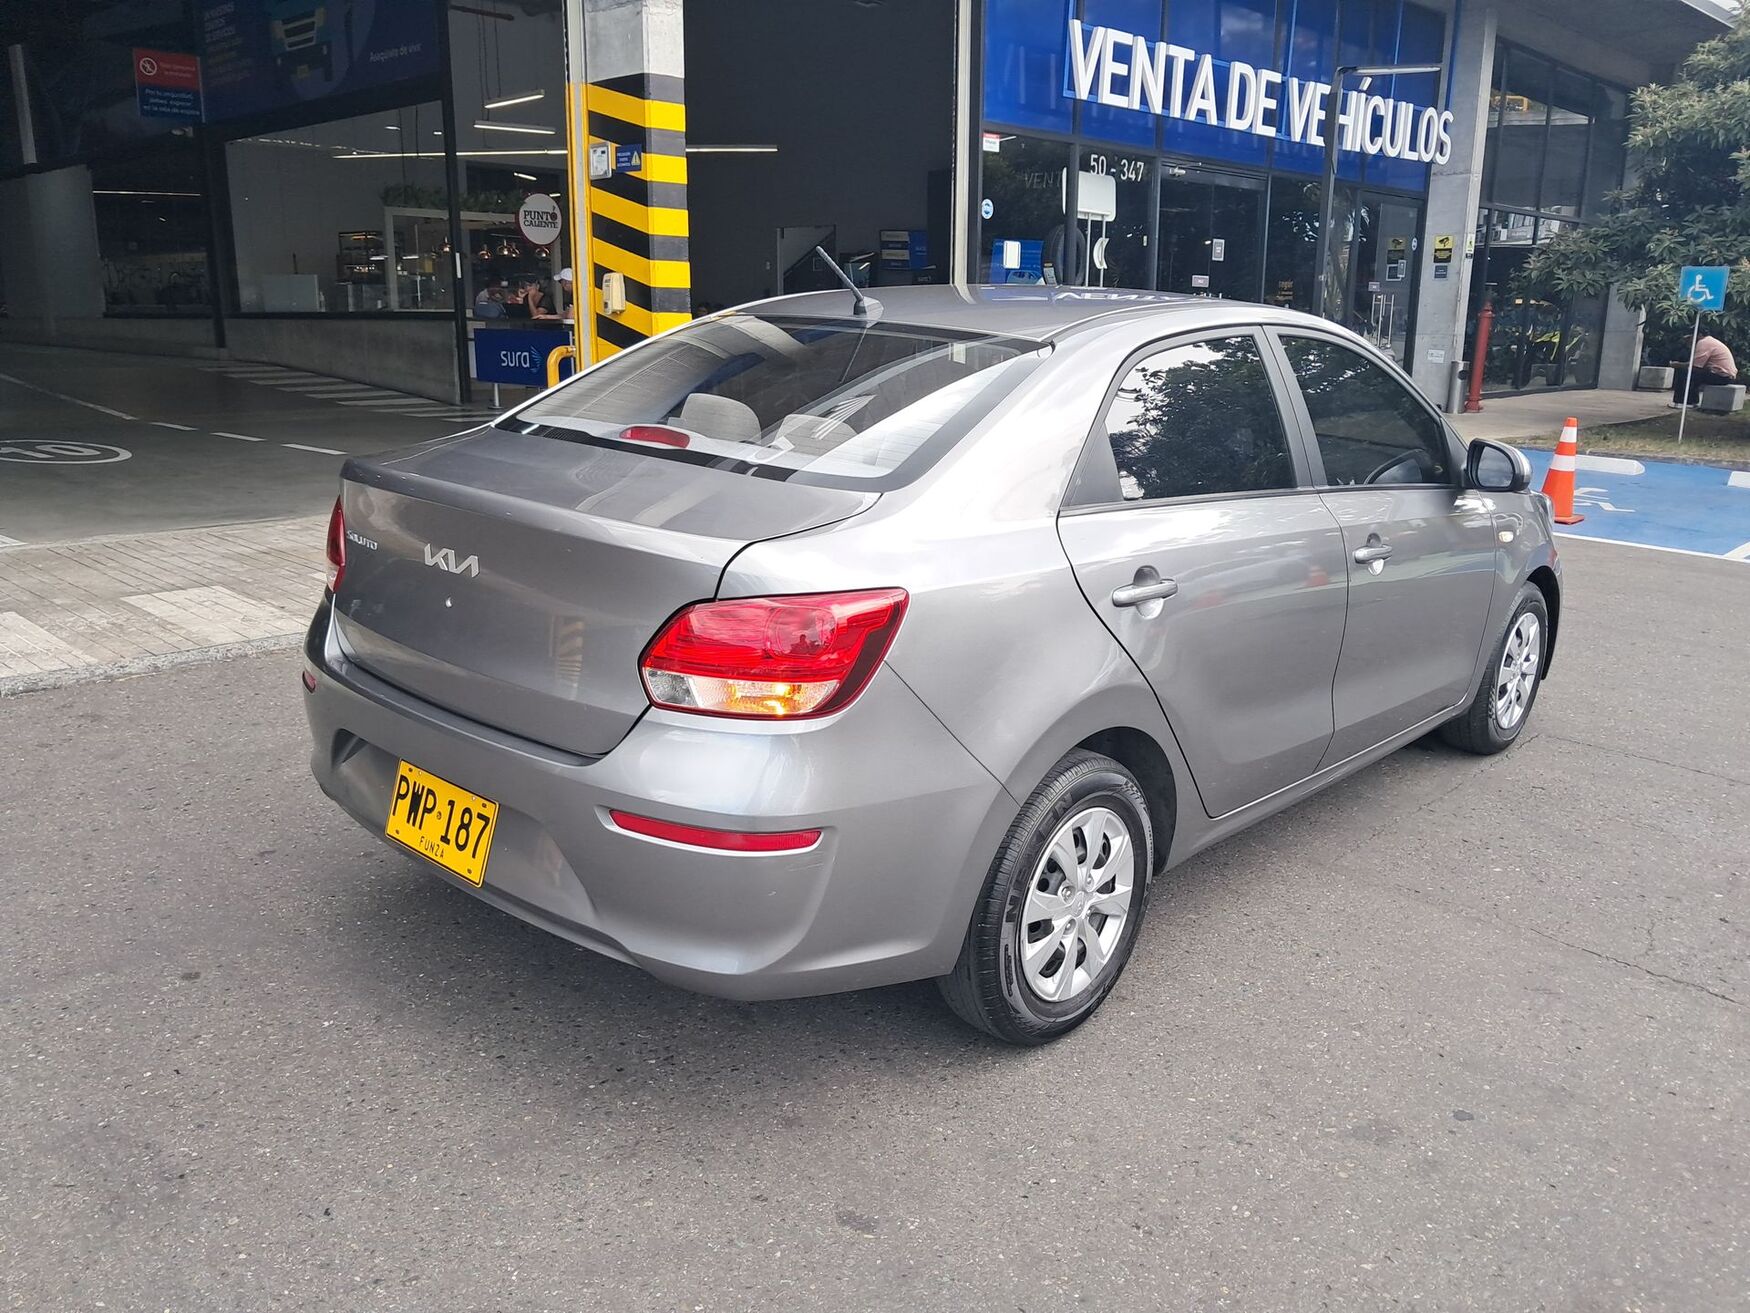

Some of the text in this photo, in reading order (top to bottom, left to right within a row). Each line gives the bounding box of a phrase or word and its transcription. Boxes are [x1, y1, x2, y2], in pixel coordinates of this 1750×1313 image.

[1069, 19, 1454, 165] VENTA DE VEHÍCULOS
[1090, 154, 1107, 176] 50
[1120, 159, 1144, 182] 347
[523, 208, 558, 221] PUNTO
[523, 219, 559, 229] CALIENTE
[500, 350, 530, 368] sura
[424, 543, 481, 578] KIA
[392, 774, 491, 859] PWP 187
[419, 835, 445, 859] FUNZA
